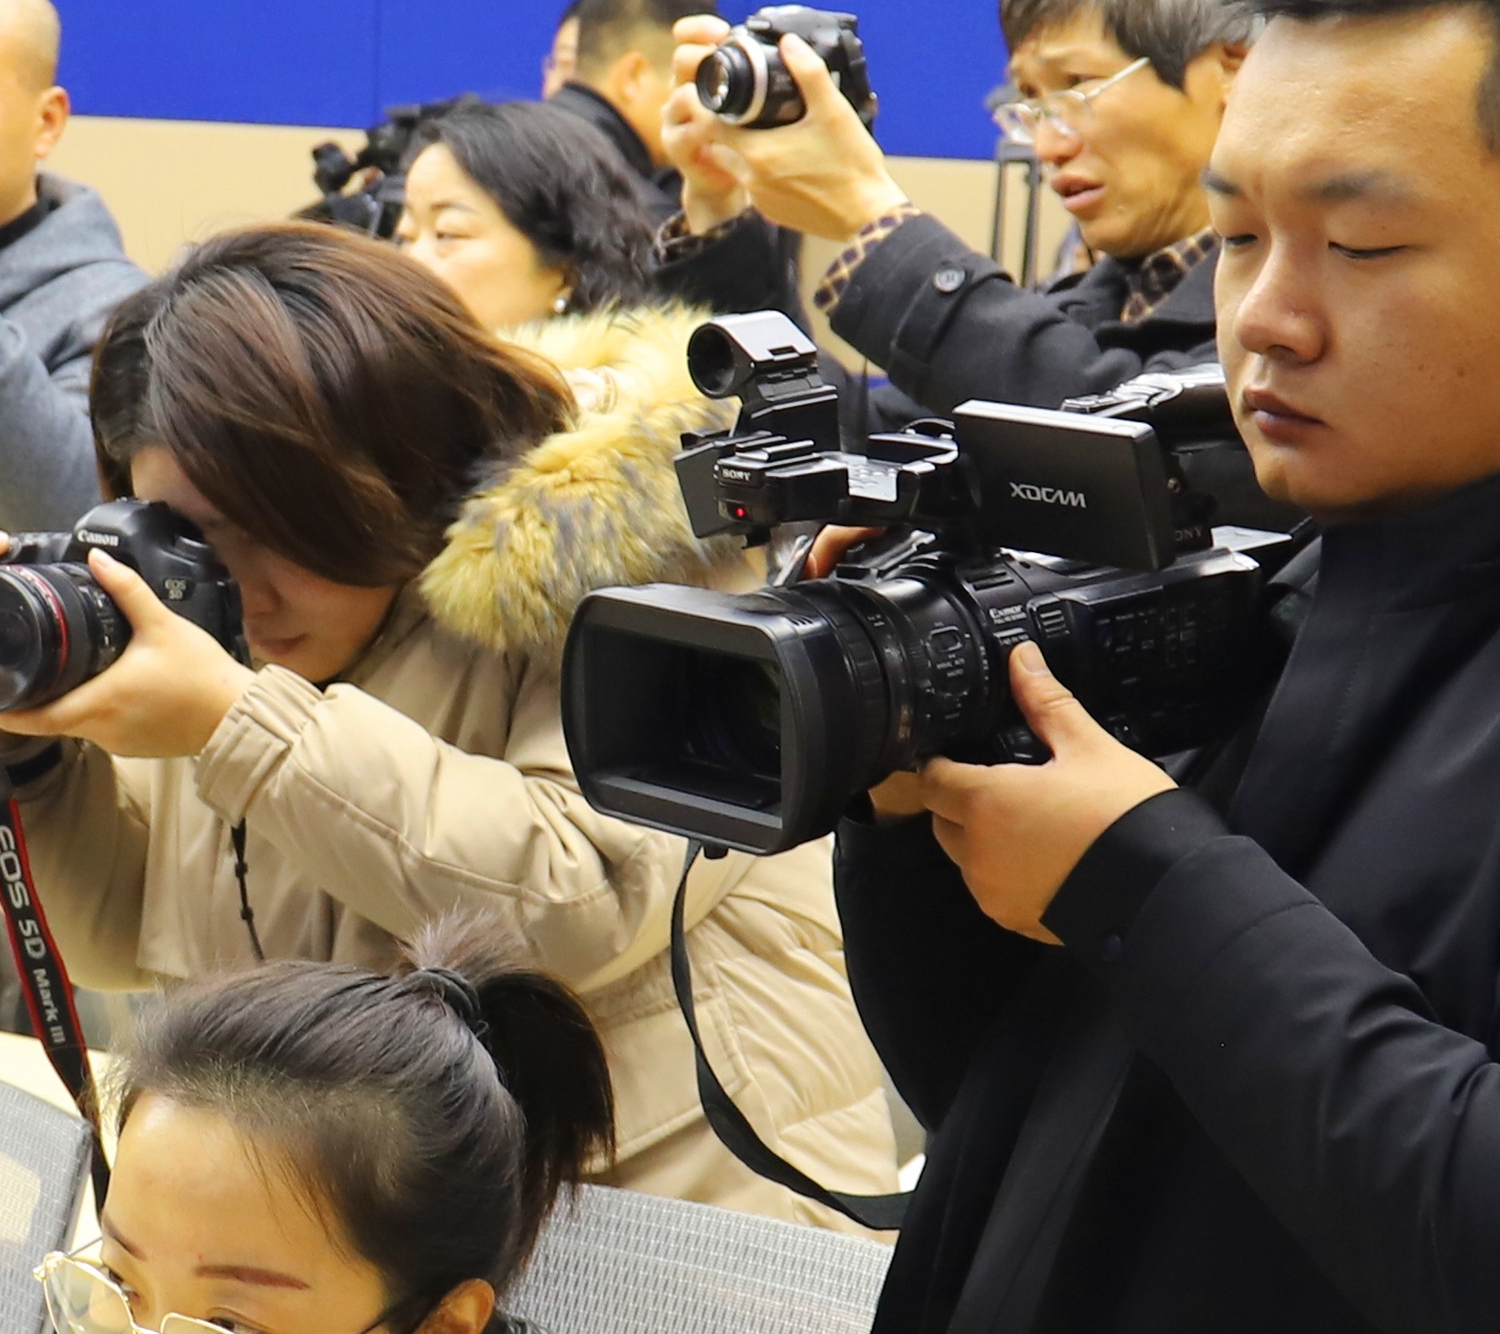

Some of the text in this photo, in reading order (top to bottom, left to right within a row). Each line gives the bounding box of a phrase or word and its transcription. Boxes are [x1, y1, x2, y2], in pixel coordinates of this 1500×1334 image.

[722, 468, 751, 481] SONY
[1009, 482, 1087, 509] XDCAM
[78, 530, 119, 546] Canon
[18, 918, 46, 959] 5D
[33, 968, 58, 1022] Mark
